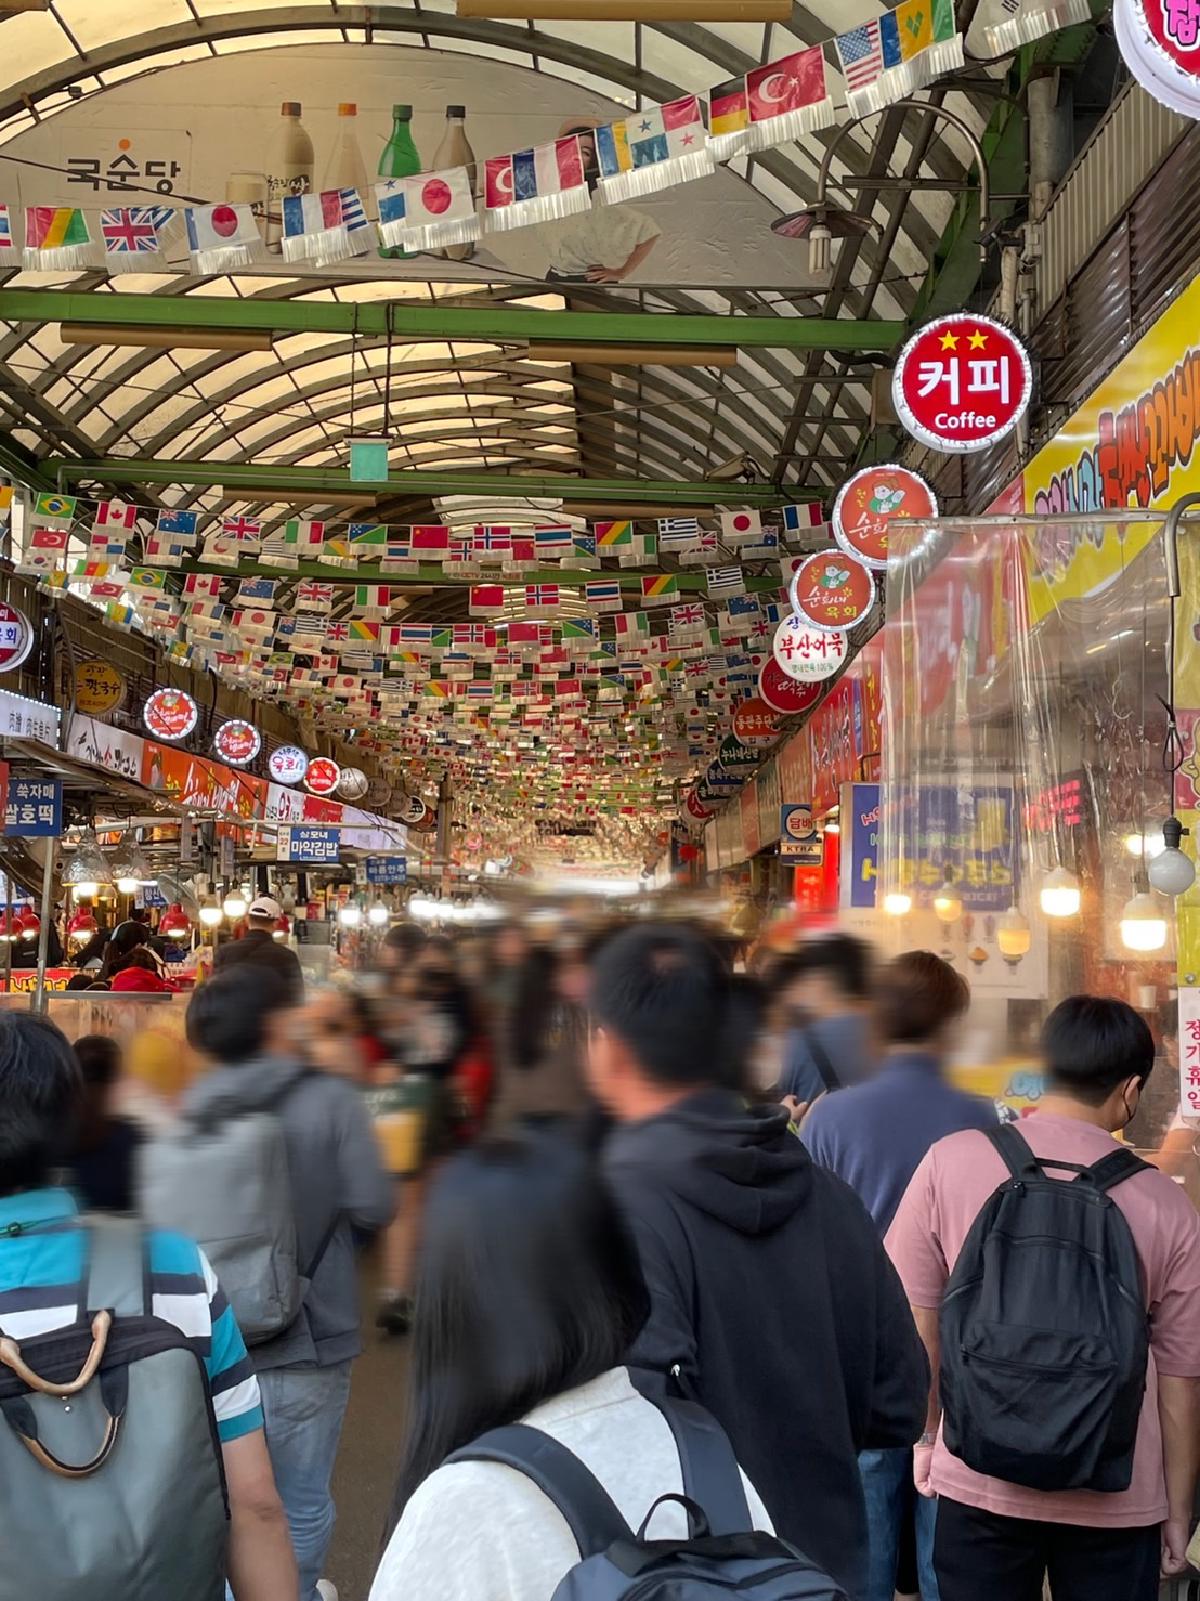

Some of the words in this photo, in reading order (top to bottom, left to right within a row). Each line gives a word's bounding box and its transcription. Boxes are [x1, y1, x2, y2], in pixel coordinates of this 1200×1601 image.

[67, 153, 182, 195] 국순당
[917, 355, 1010, 406] 커피
[934, 411, 996, 430] Coffee
[779, 632, 844, 660] 부산어묵
[16, 783, 55, 800] 쑥자매
[290, 840, 338, 857] 마약김밥
